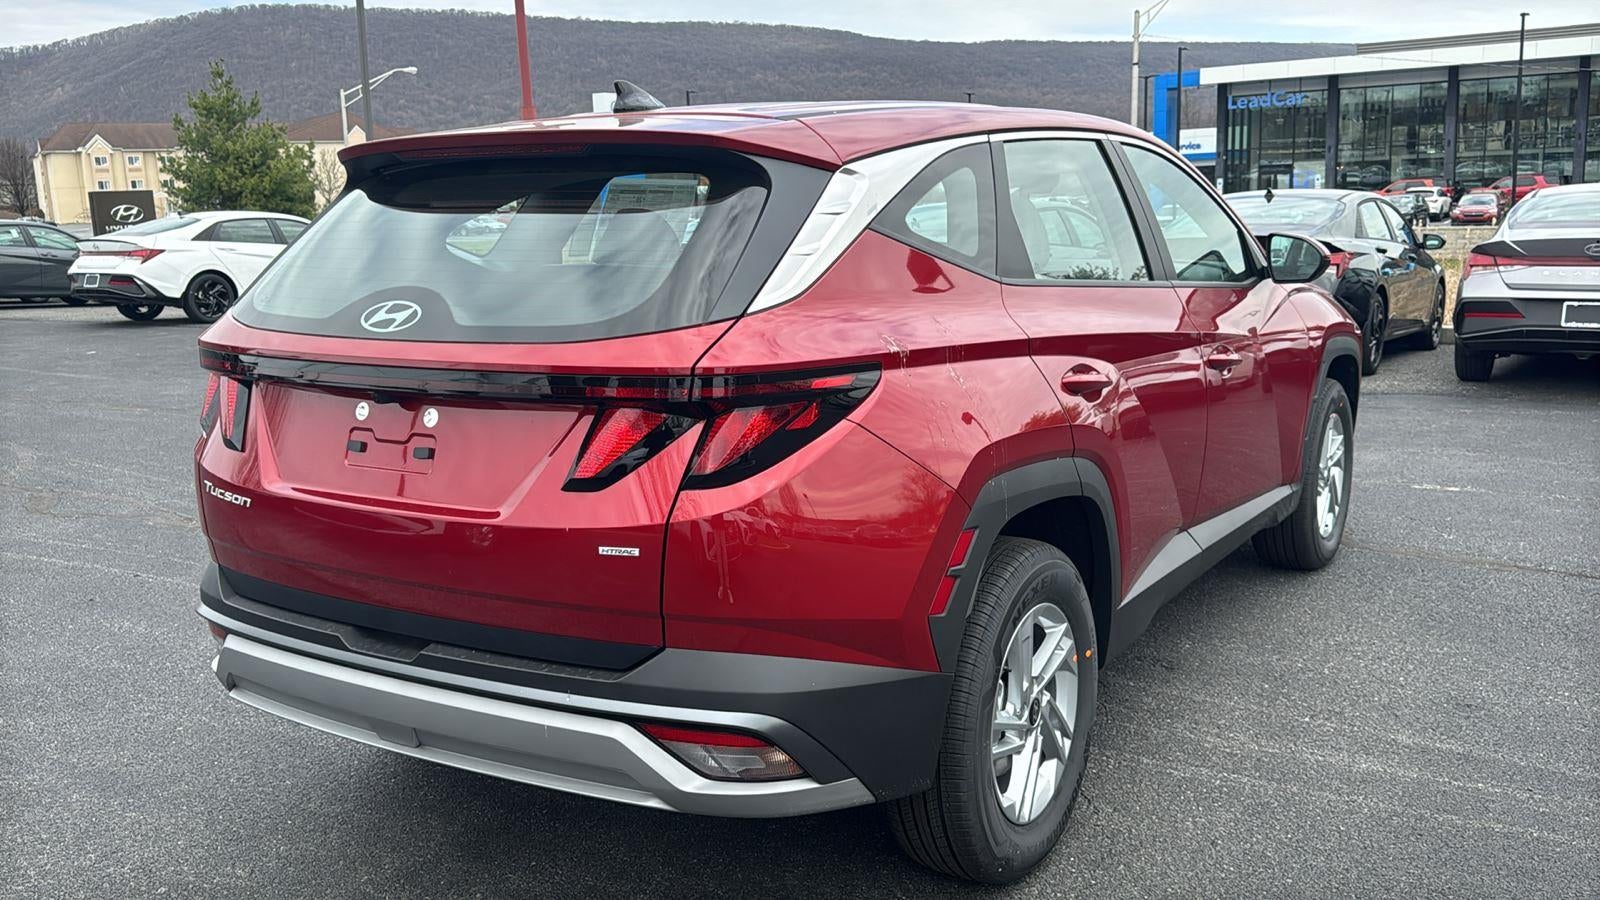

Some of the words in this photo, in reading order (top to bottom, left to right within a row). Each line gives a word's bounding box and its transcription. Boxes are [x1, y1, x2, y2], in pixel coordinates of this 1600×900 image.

[1227, 89, 1306, 110] LeadCar
[1180, 141, 1202, 151] rvice
[600, 547, 637, 555] HTRAC
